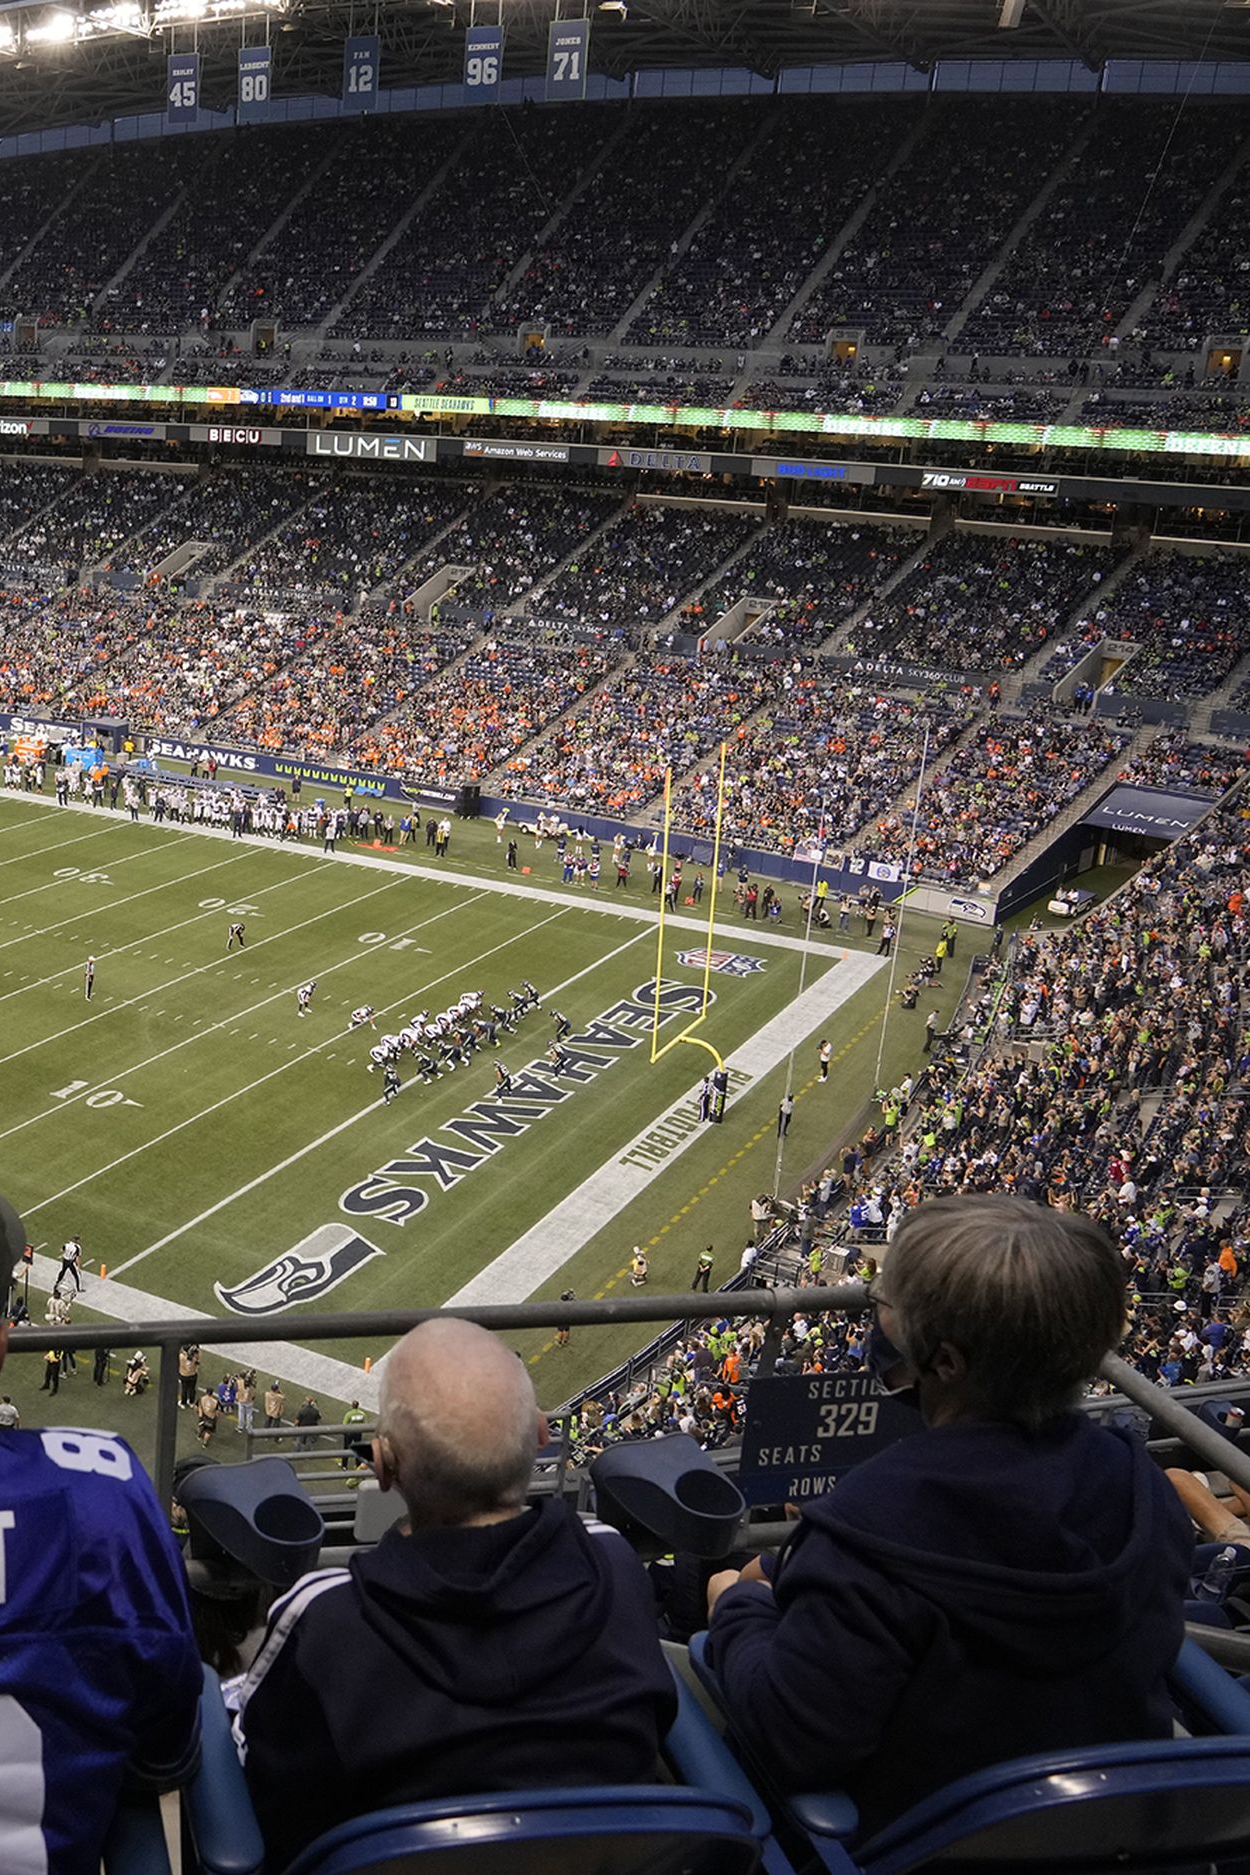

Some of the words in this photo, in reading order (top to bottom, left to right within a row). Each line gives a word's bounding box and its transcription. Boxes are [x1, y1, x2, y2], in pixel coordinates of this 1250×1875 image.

[466, 56, 498, 86] 96
[553, 51, 580, 81] 71
[241, 74, 268, 103] 80
[348, 64, 374, 93] 12
[168, 81, 196, 108] 45
[414, 398, 440, 409] SEATTLE
[441, 399, 476, 411] SEAHAWKS
[316, 434, 426, 460] LUMEN
[484, 445, 514, 456] Amazon
[515, 448, 533, 457] Web
[535, 449, 567, 460] Services
[629, 451, 701, 470] DELTA
[777, 463, 806, 476] BUD
[806, 466, 846, 479] LIGHT
[922, 473, 950, 487] 710
[965, 476, 1018, 492] ESPN
[1018, 482, 1055, 492] SEATTLE
[250, 587, 279, 598] DELTA
[538, 619, 570, 631] DELTA
[865, 662, 904, 675] DELTA
[151, 737, 257, 770] SEAHAWKS
[1101, 805, 1191, 829] LUMEN
[1111, 823, 1148, 835] LUMEN
[53, 866, 110, 884] 30
[197, 897, 260, 916] 20
[357, 932, 418, 951] 10
[50, 1080, 124, 1109] 10
[338, 976, 717, 1227] SEAHAWKS
[808, 1378, 881, 1400] SECTIO
[816, 1402, 879, 1438] 329
[40, 1426, 133, 1482] 8
[758, 1444, 822, 1467] SEATS
[788, 1475, 837, 1497] ROWS
